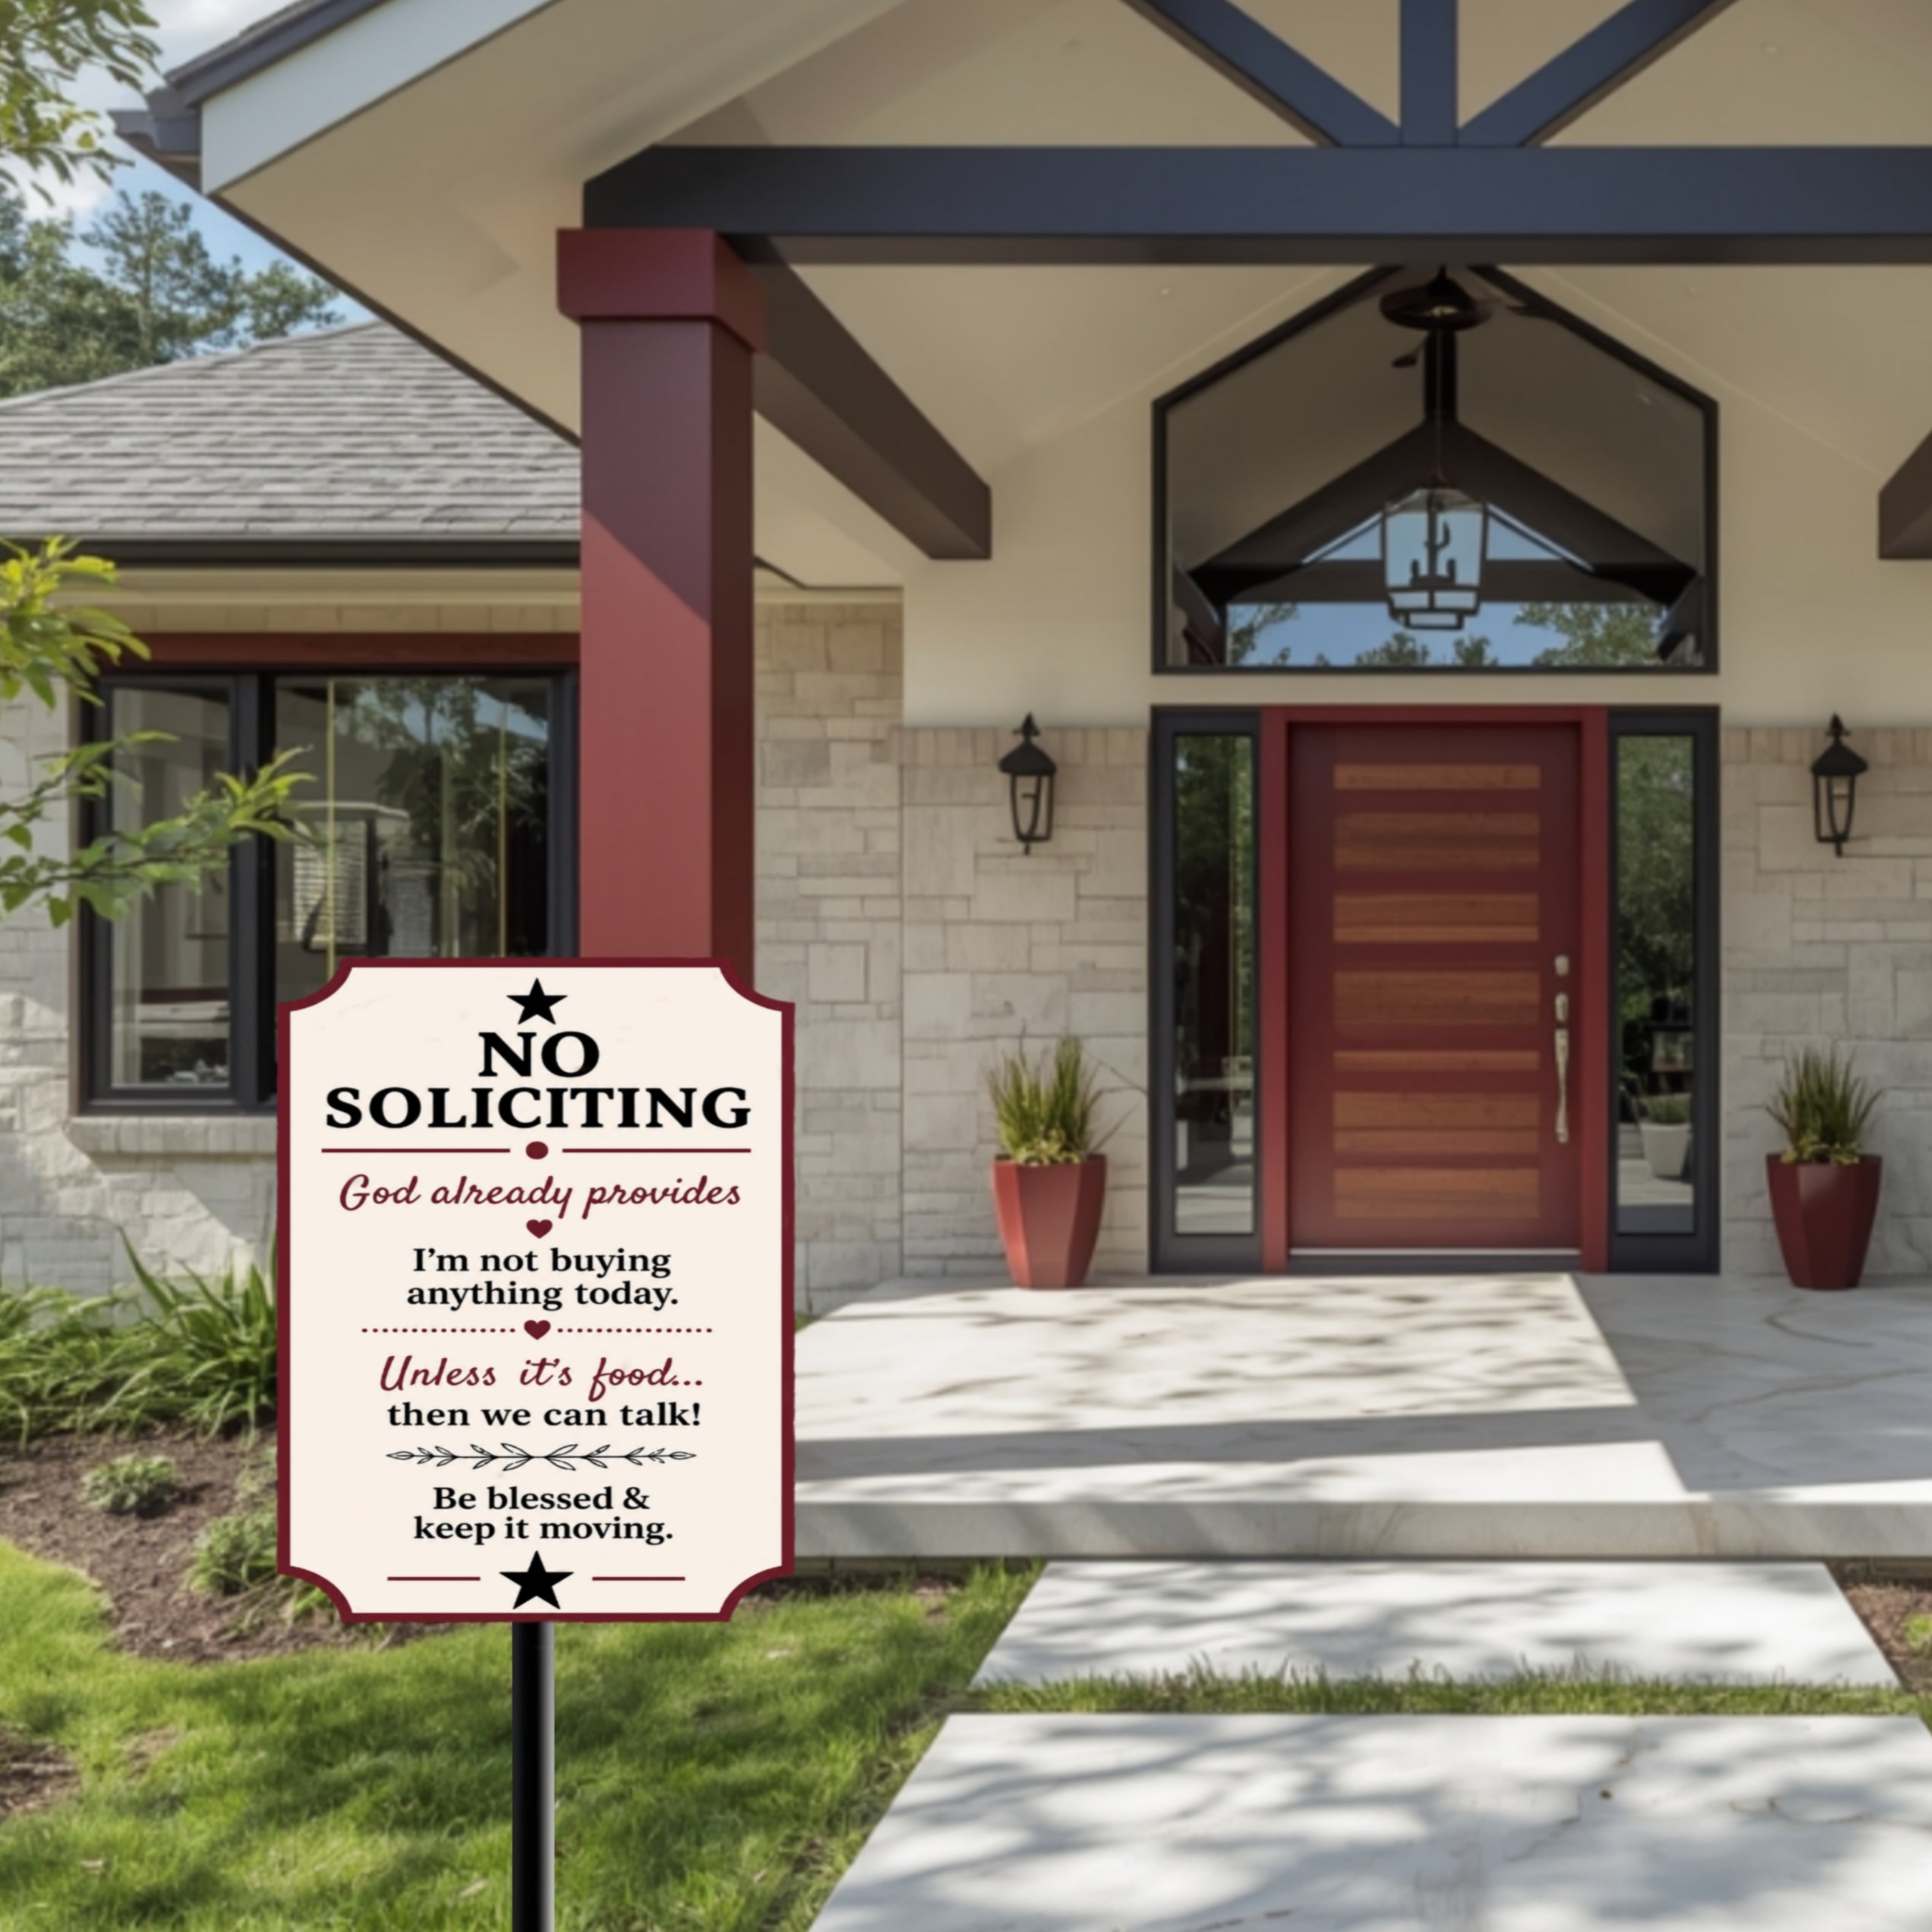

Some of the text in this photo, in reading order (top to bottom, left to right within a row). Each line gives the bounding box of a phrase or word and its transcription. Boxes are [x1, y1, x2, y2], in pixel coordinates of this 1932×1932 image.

[477, 1030, 601, 1079] NO
[325, 1086, 752, 1130] SOLICITING
[338, 1173, 741, 1221] God already provides
[479, 1250, 540, 1273] not
[549, 1246, 672, 1280] buying
[406, 1279, 679, 1312] anything today.
[379, 1354, 497, 1392] Unless
[587, 1356, 704, 1403] food...
[386, 1400, 701, 1427] then we can talk!
[432, 1485, 651, 1511] Be blessed &
[413, 1514, 674, 1547] keep it moving.
